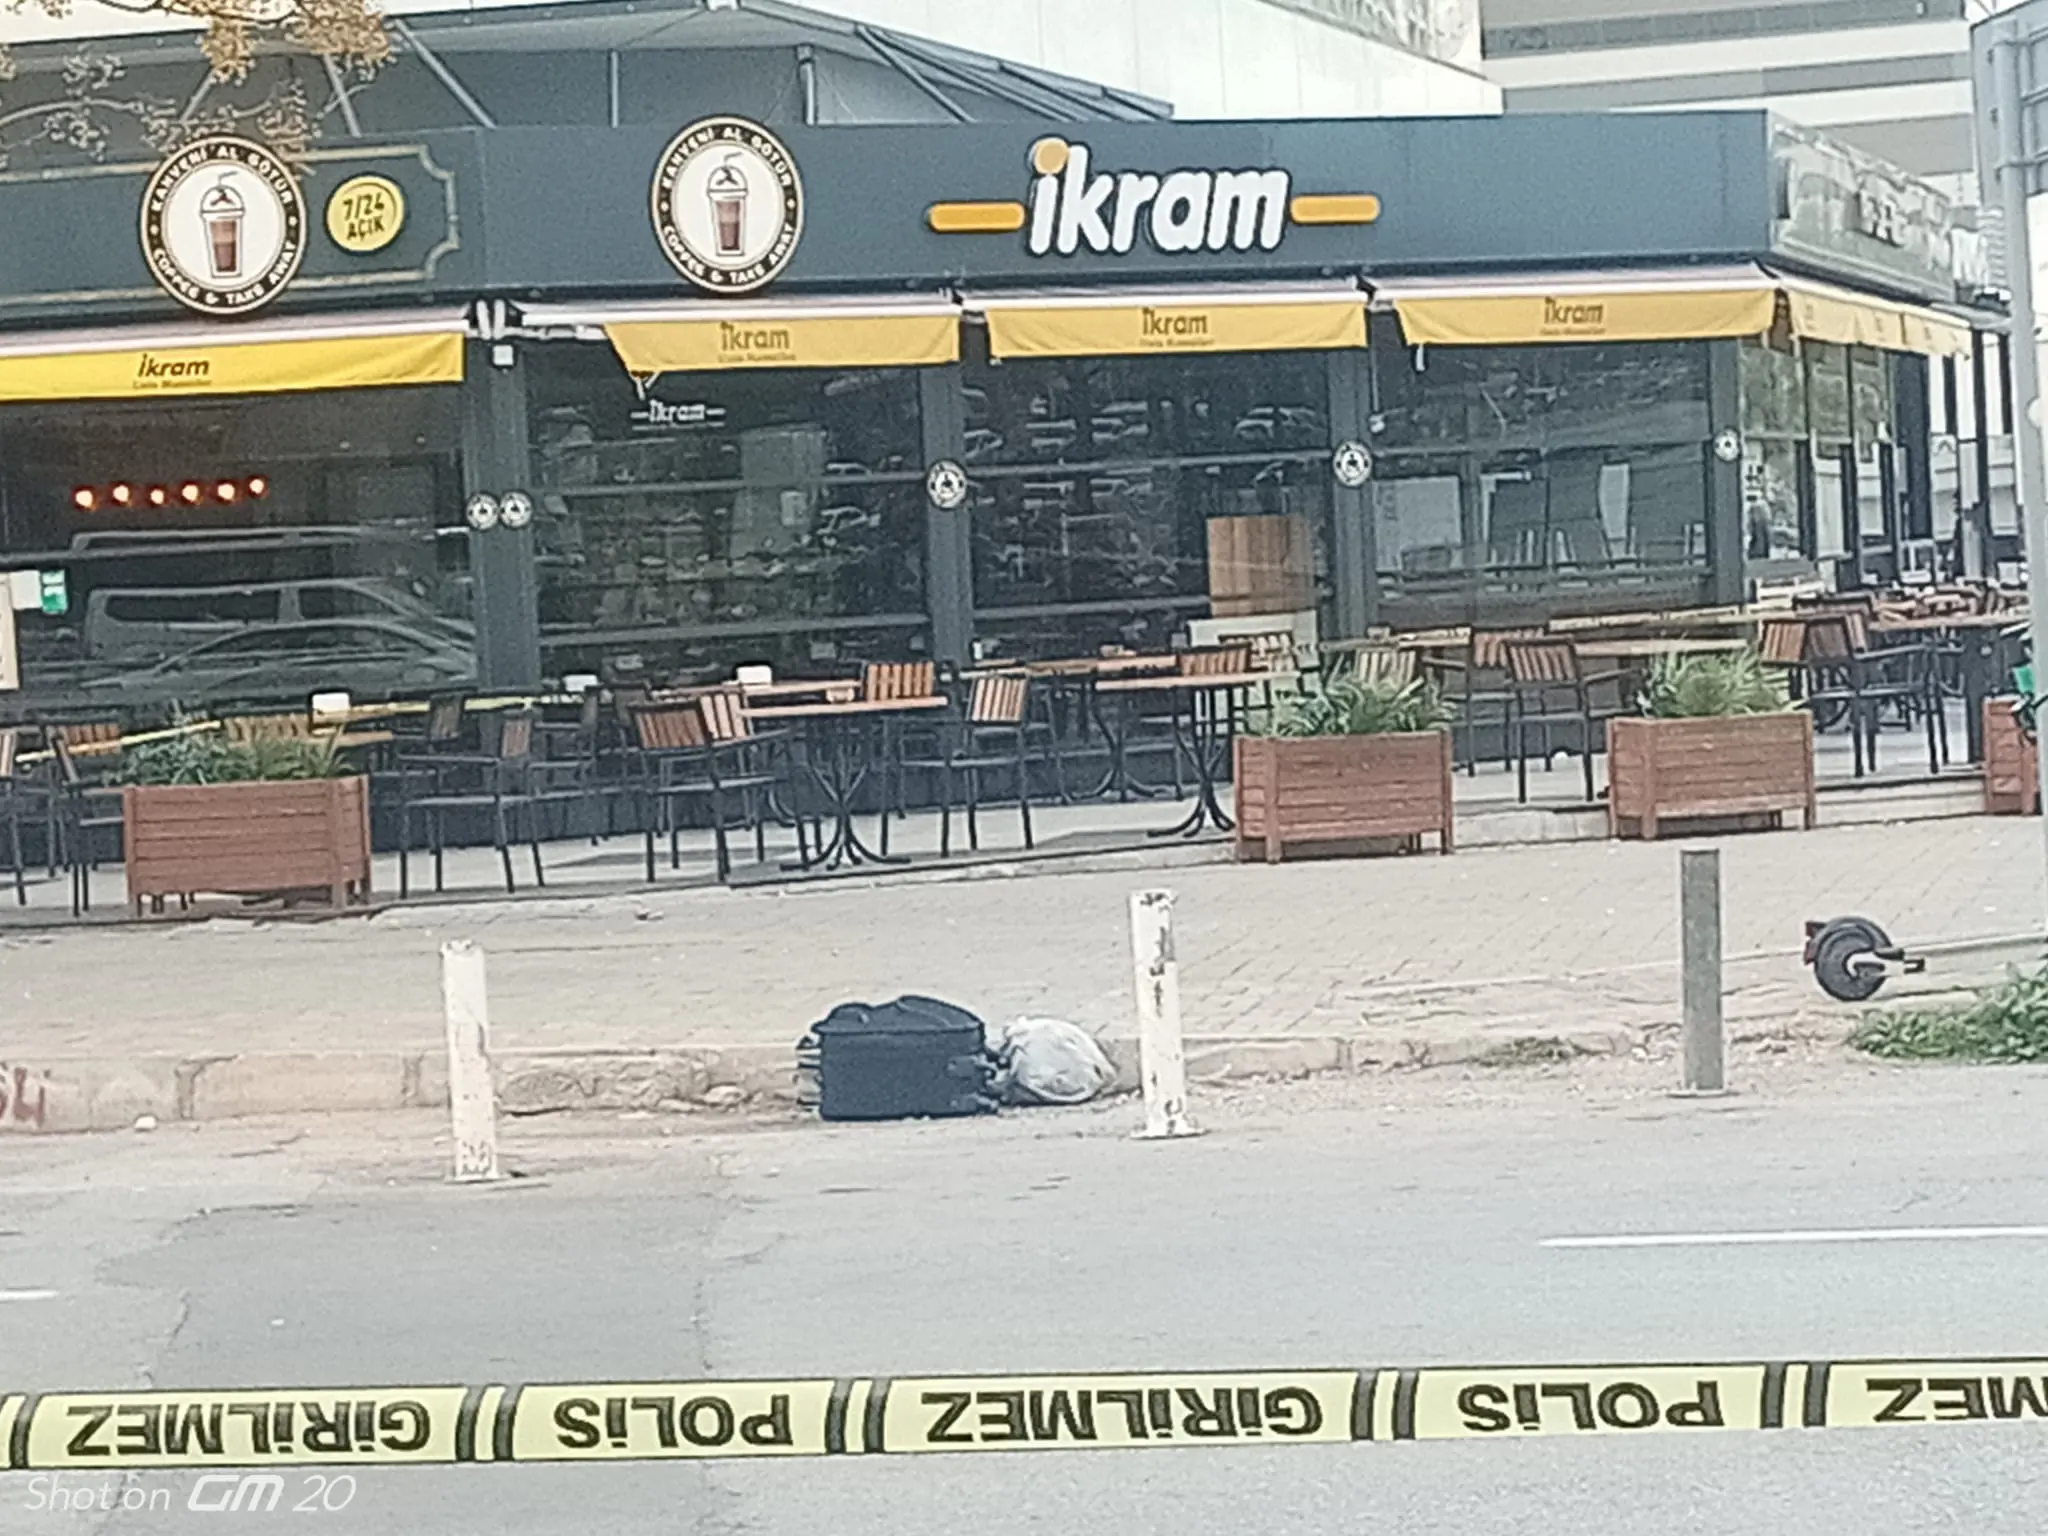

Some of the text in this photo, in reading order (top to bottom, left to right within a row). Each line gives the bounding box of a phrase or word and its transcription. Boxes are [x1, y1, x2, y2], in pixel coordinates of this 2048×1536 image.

[722, 126, 743, 141] AL
[216, 145, 239, 159] AL
[342, 192, 385, 220] 7/24
[1028, 137, 1292, 256] ikram
[663, 223, 795, 284] COFFEE & TAKE AWAY
[153, 240, 297, 304] COFFEE & TAKE AWAY
[719, 320, 790, 350] ikram
[1142, 306, 1208, 335] ikram
